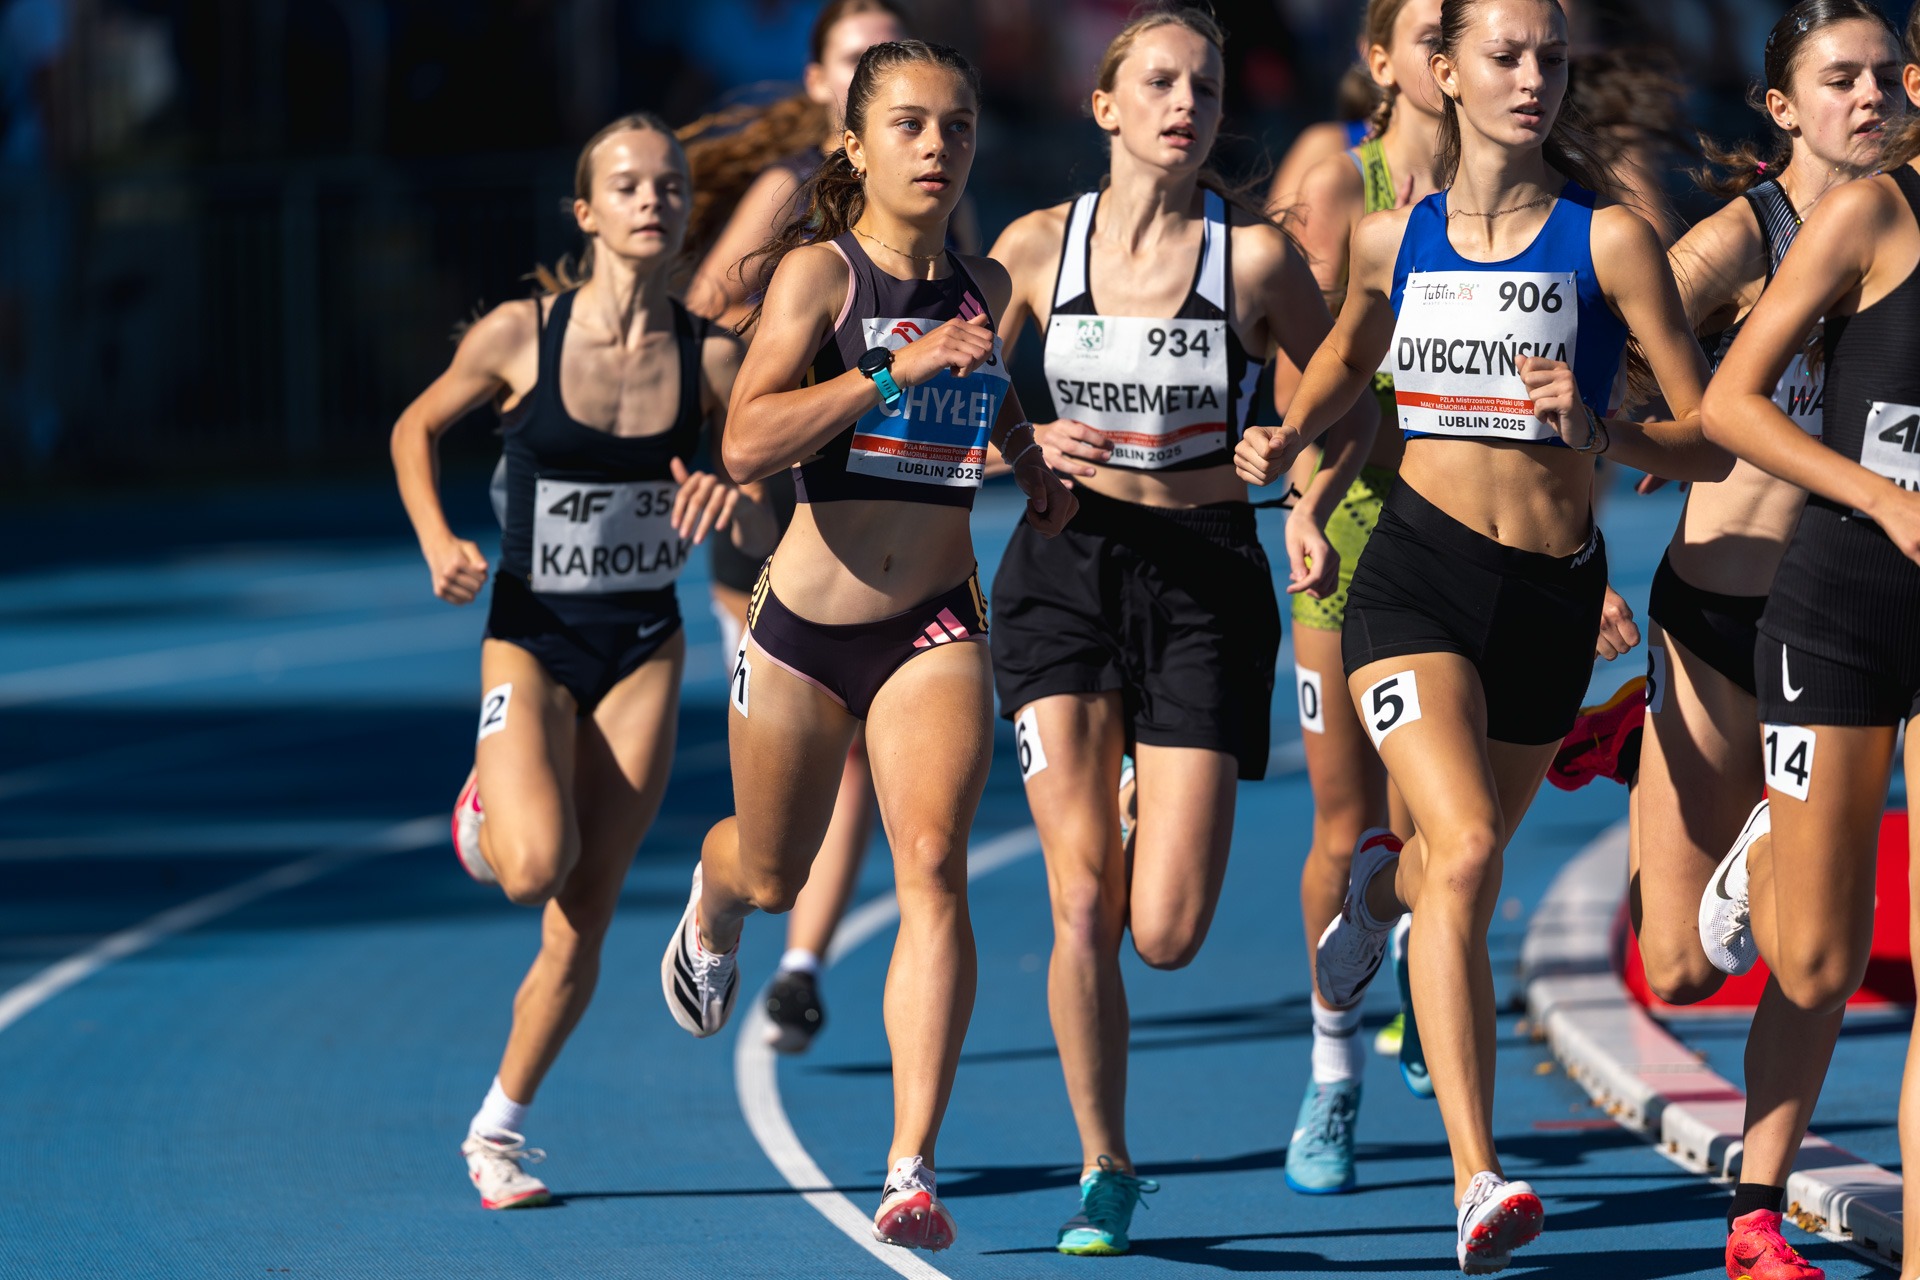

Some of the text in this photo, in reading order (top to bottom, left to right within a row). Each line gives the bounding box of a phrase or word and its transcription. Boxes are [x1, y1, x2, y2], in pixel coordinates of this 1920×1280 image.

[1498, 281, 1563, 313] 906
[1147, 327, 1211, 358] 934
[1056, 379, 1219, 416] SZEREMETA
[1435, 402, 1468, 411] MEMORIAŁ
[1468, 404, 1498, 412] JANUSZA
[1455, 397, 1495, 405] Mistrzostwa
[1495, 398, 1513, 406] Polski
[1438, 415, 1526, 431] LUBLIN 2025
[877, 446, 896, 455] MAŁY
[897, 449, 928, 460] MEMORIAŁ
[928, 453, 954, 462] JANUSZA
[903, 442, 918, 451] PZLA
[919, 444, 952, 454] Mistrzostwa
[1147, 445, 1182, 462] 2025
[896, 461, 983, 480] LUBLIN 2025
[547, 489, 614, 523] 4F
[635, 488, 677, 518] 35
[540, 538, 691, 577] KAROLAK
[1570, 533, 1598, 569] NIKE
[482, 694, 506, 729] 2
[1372, 678, 1404, 731] 5
[1016, 720, 1032, 775] 6
[1765, 730, 1809, 786] 14
